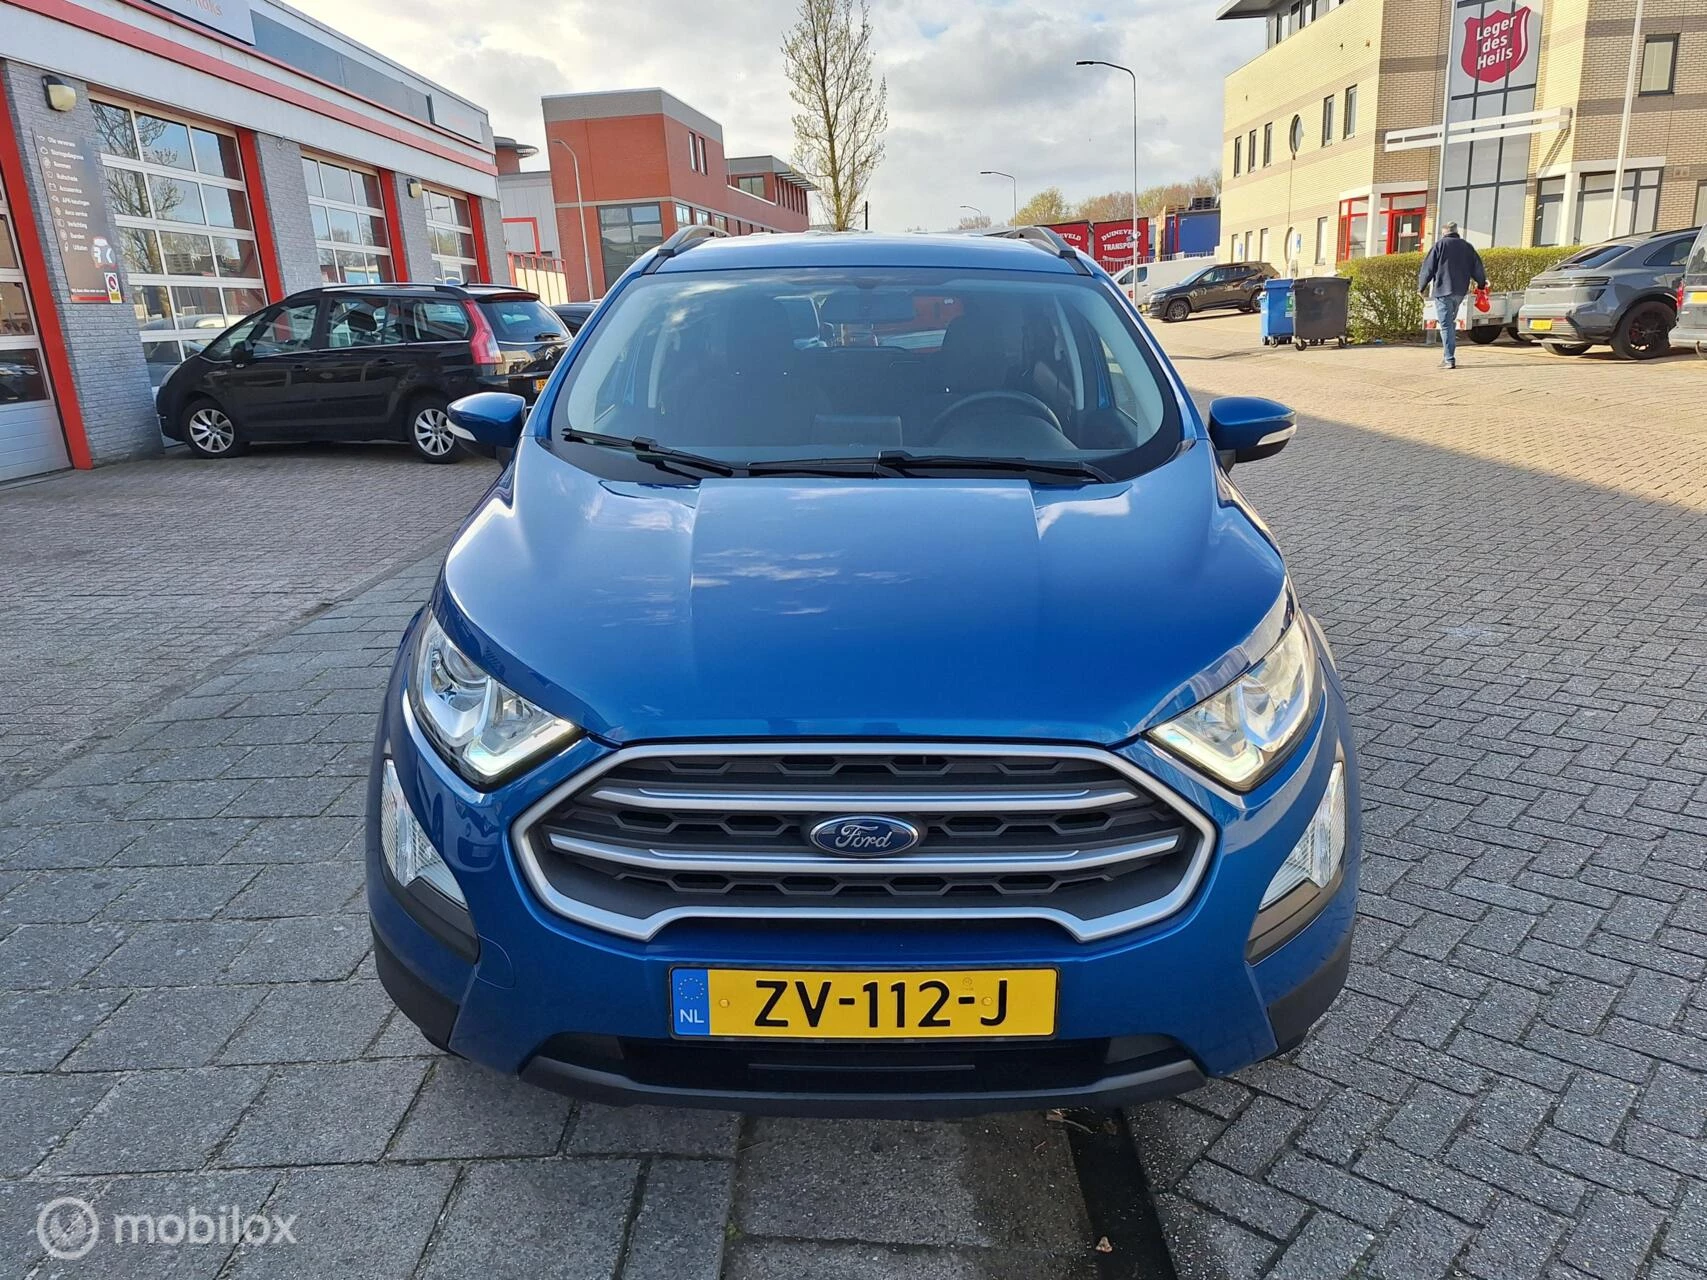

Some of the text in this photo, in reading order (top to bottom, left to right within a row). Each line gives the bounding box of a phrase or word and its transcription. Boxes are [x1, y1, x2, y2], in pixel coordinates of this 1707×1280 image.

[1477, 16, 1517, 41] Leger
[1482, 35, 1508, 53] des
[1477, 47, 1513, 70] Heils
[1101, 229, 1142, 241] DUINEVED
[834, 824, 892, 849] Ford
[754, 979, 1009, 1028] ZV-112-J
[680, 1008, 704, 1024] NL
